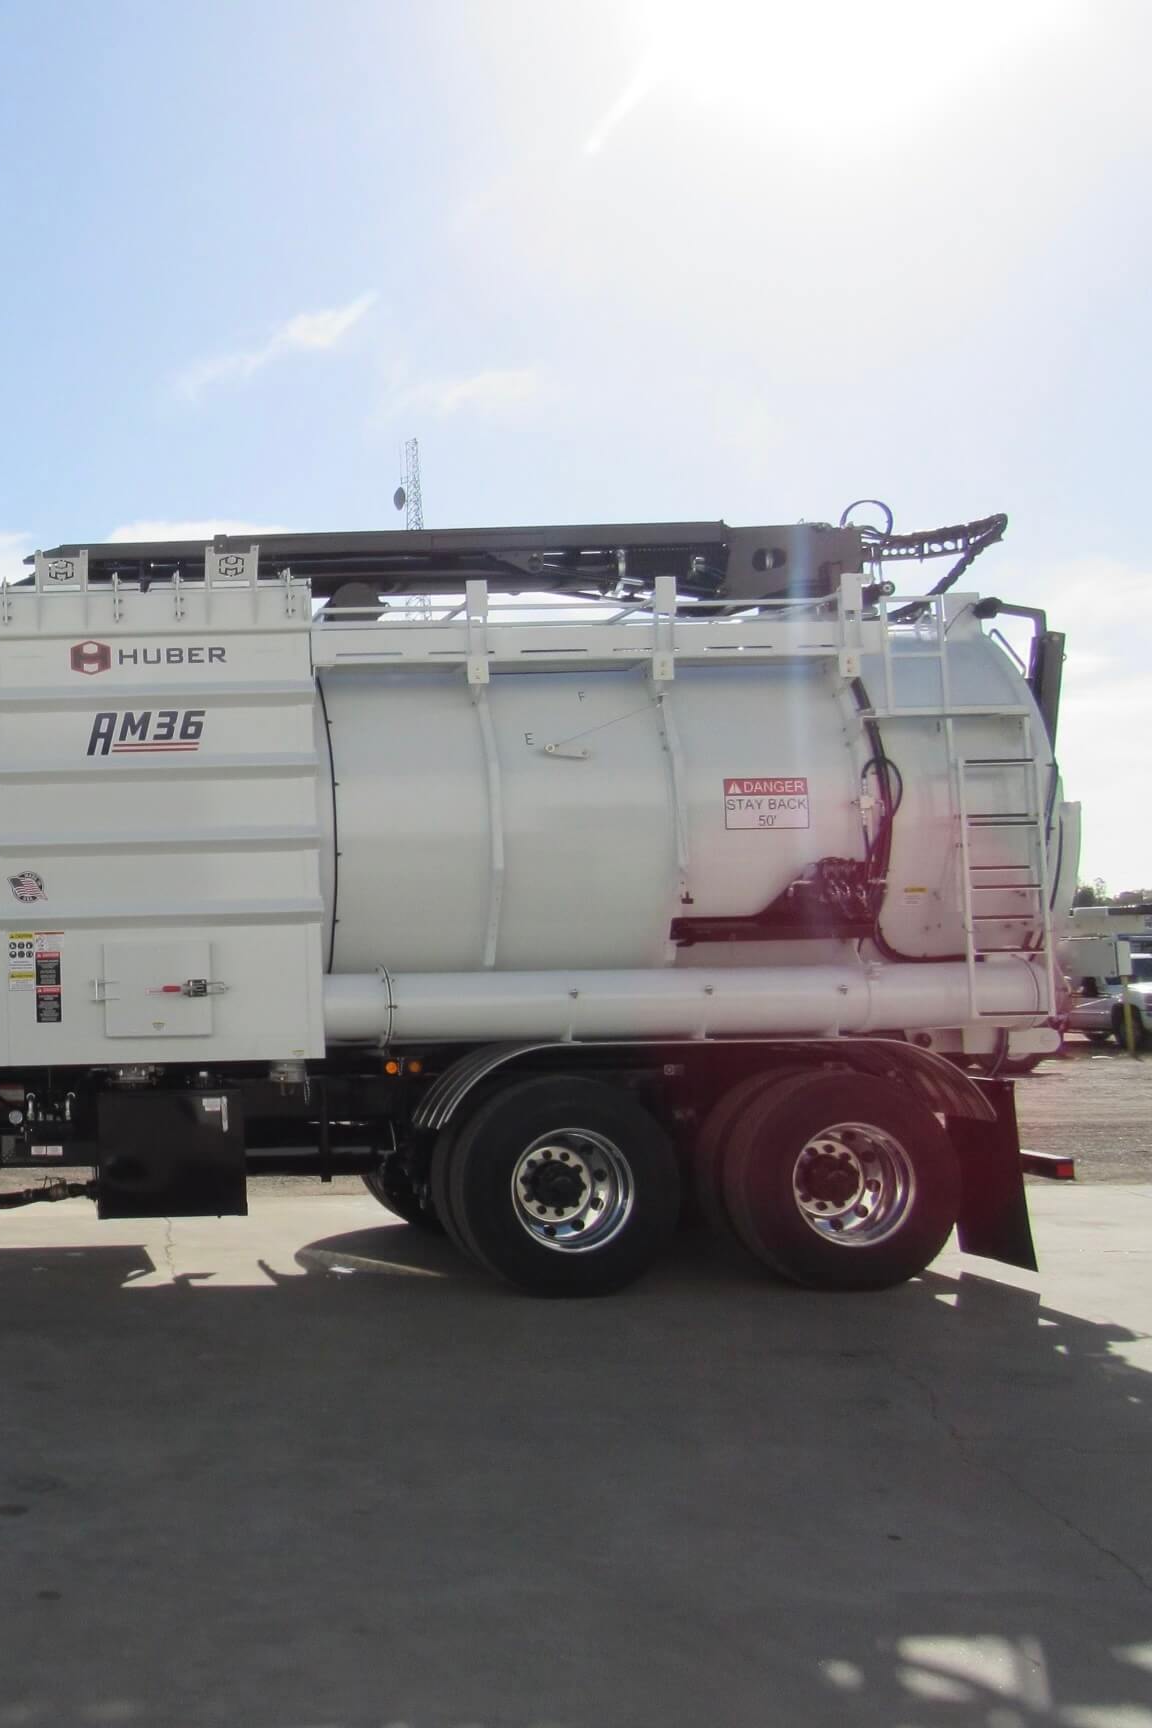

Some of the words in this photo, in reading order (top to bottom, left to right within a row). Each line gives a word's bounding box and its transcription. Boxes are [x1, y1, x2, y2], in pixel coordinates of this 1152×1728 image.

[118, 647, 227, 665] HUBER
[577, 691, 585, 702] F
[86, 710, 206, 756] AM36
[524, 732, 535, 746] E
[743, 780, 805, 793] DANGER
[727, 798, 763, 810] STAY
[768, 798, 807, 810] BACK
